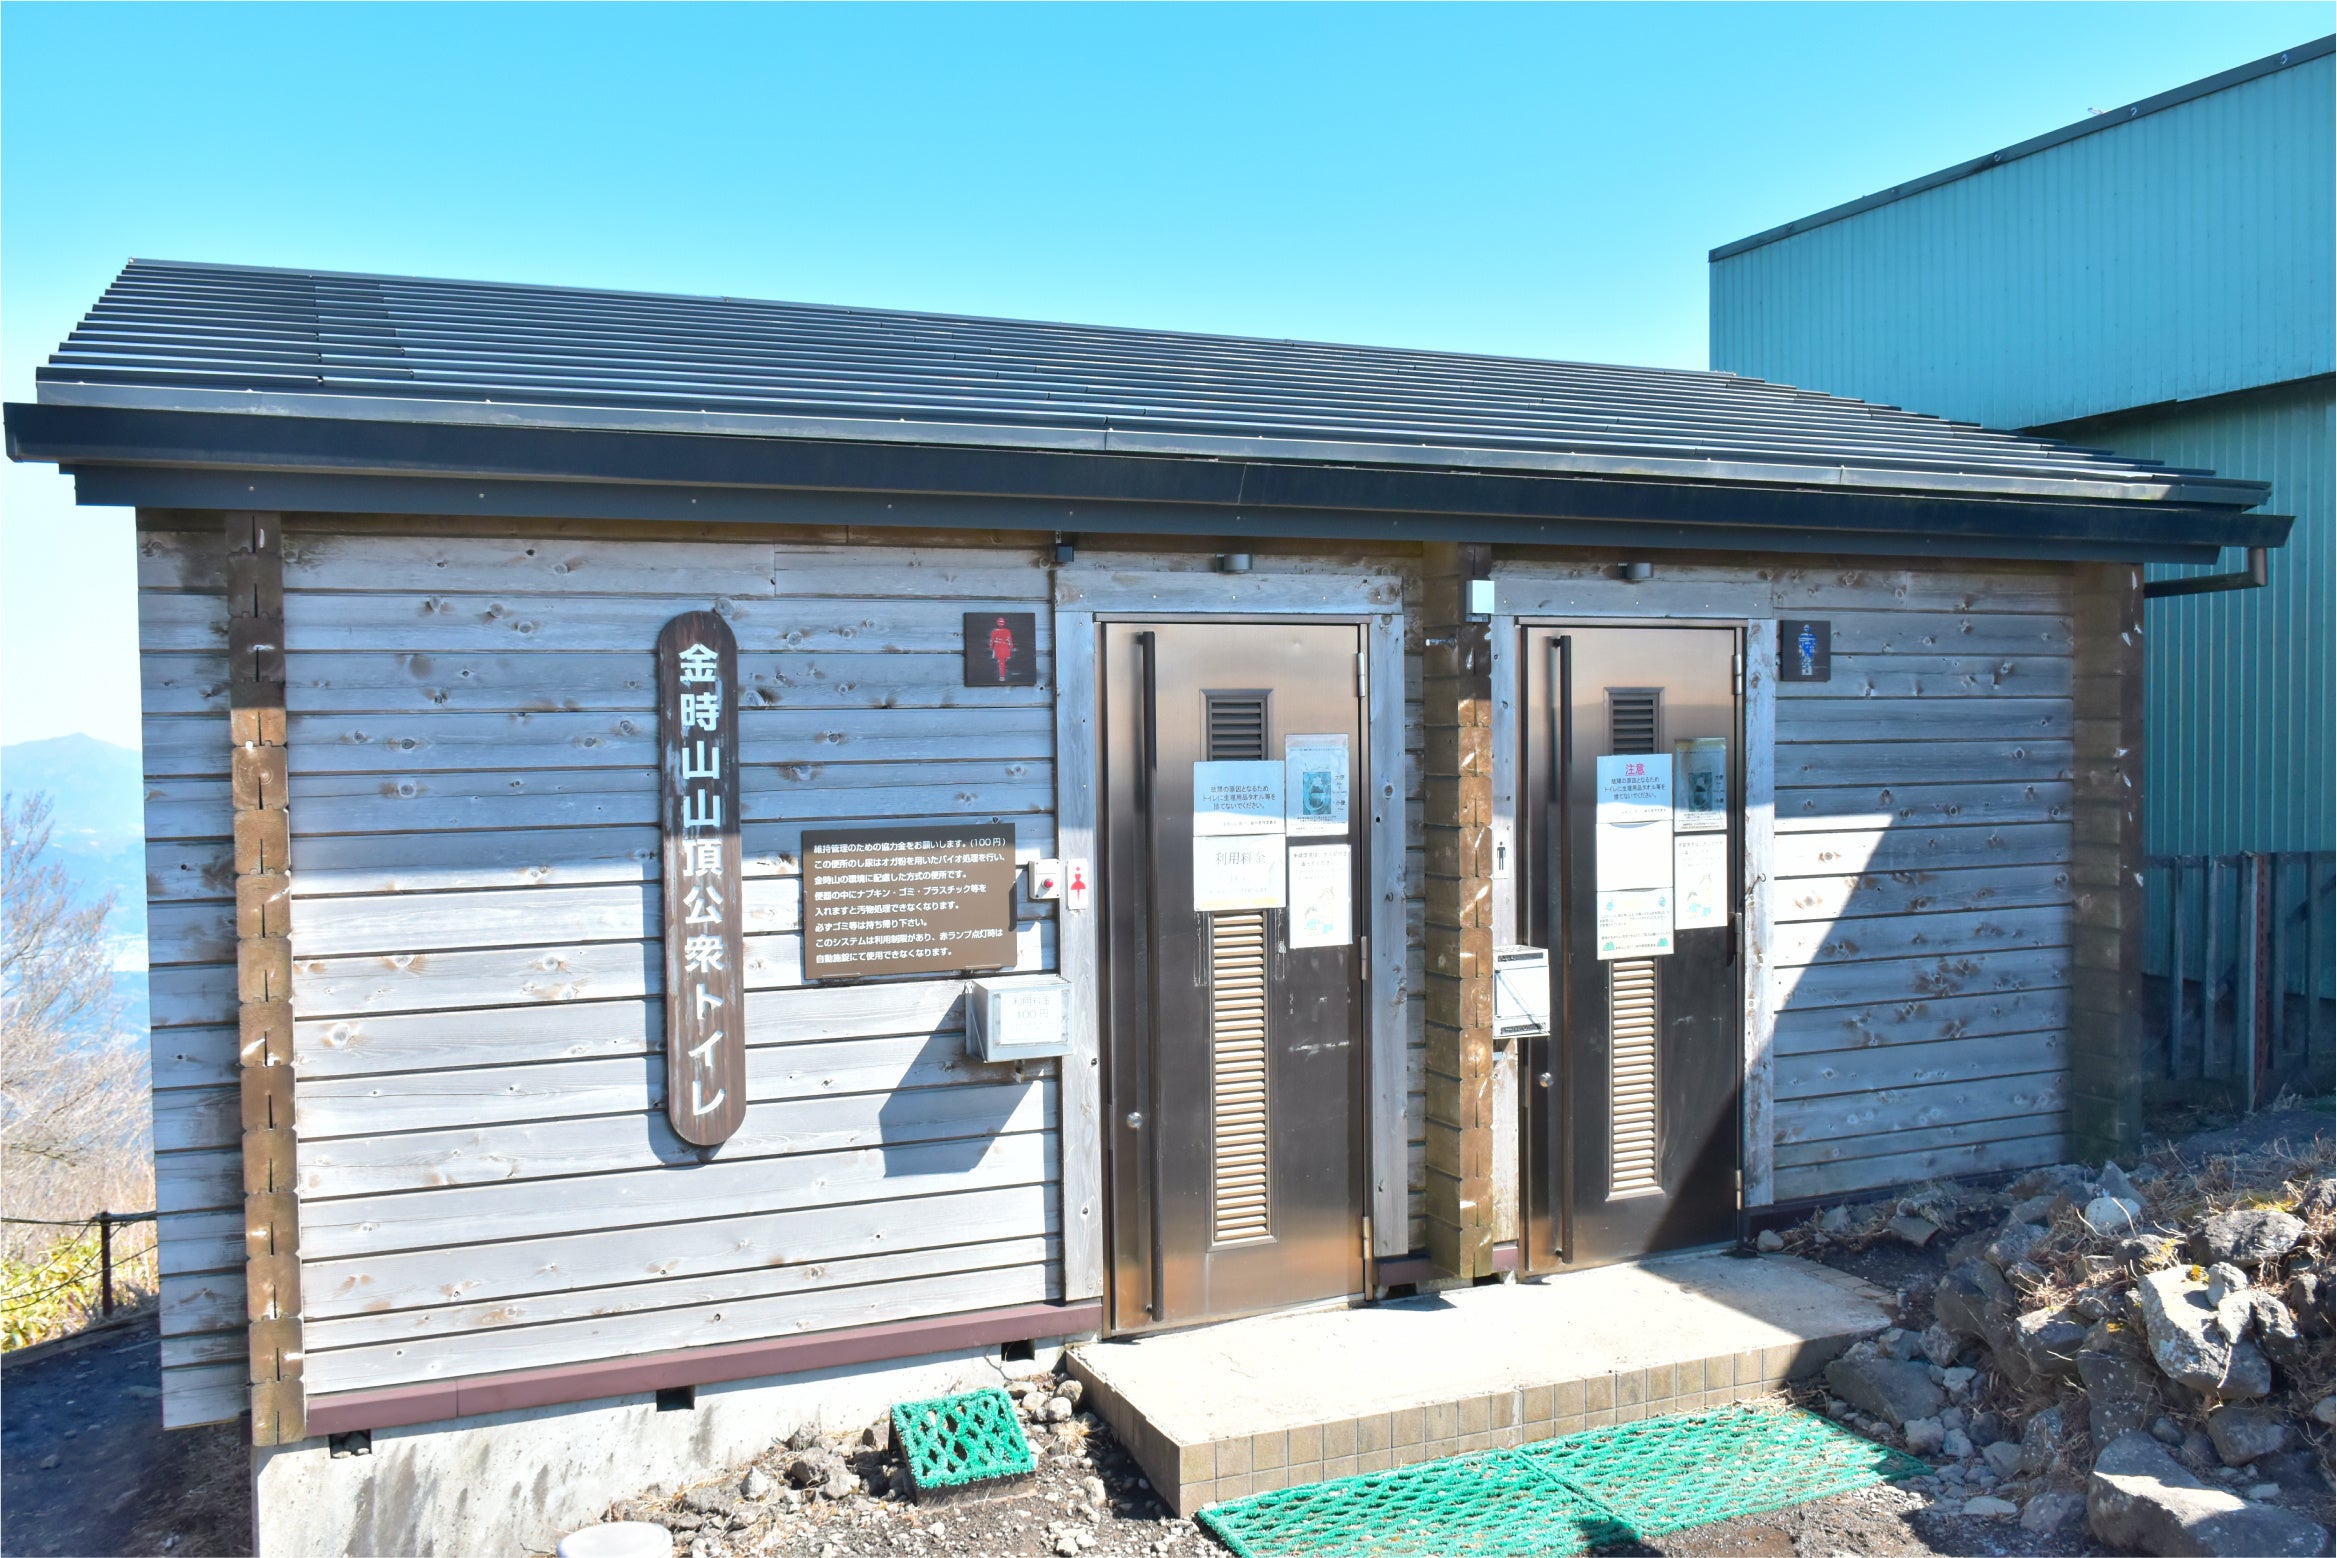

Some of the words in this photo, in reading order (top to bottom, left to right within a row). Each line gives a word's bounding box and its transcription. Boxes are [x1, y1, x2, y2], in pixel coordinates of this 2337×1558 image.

[1625, 763, 1645, 775] 注意
[678, 643, 726, 1117] 金時山山頂公衆トイレ
[814, 870, 968, 886] 金時山の環境に配慮した方式の便所です。
[815, 901, 960, 917] 入れますと汚物処理できなくなります。
[815, 917, 928, 933] 必ずゴミ等は持ち帰り下さい。
[816, 947, 953, 964] 自動施錠にて使用できなくなります。
